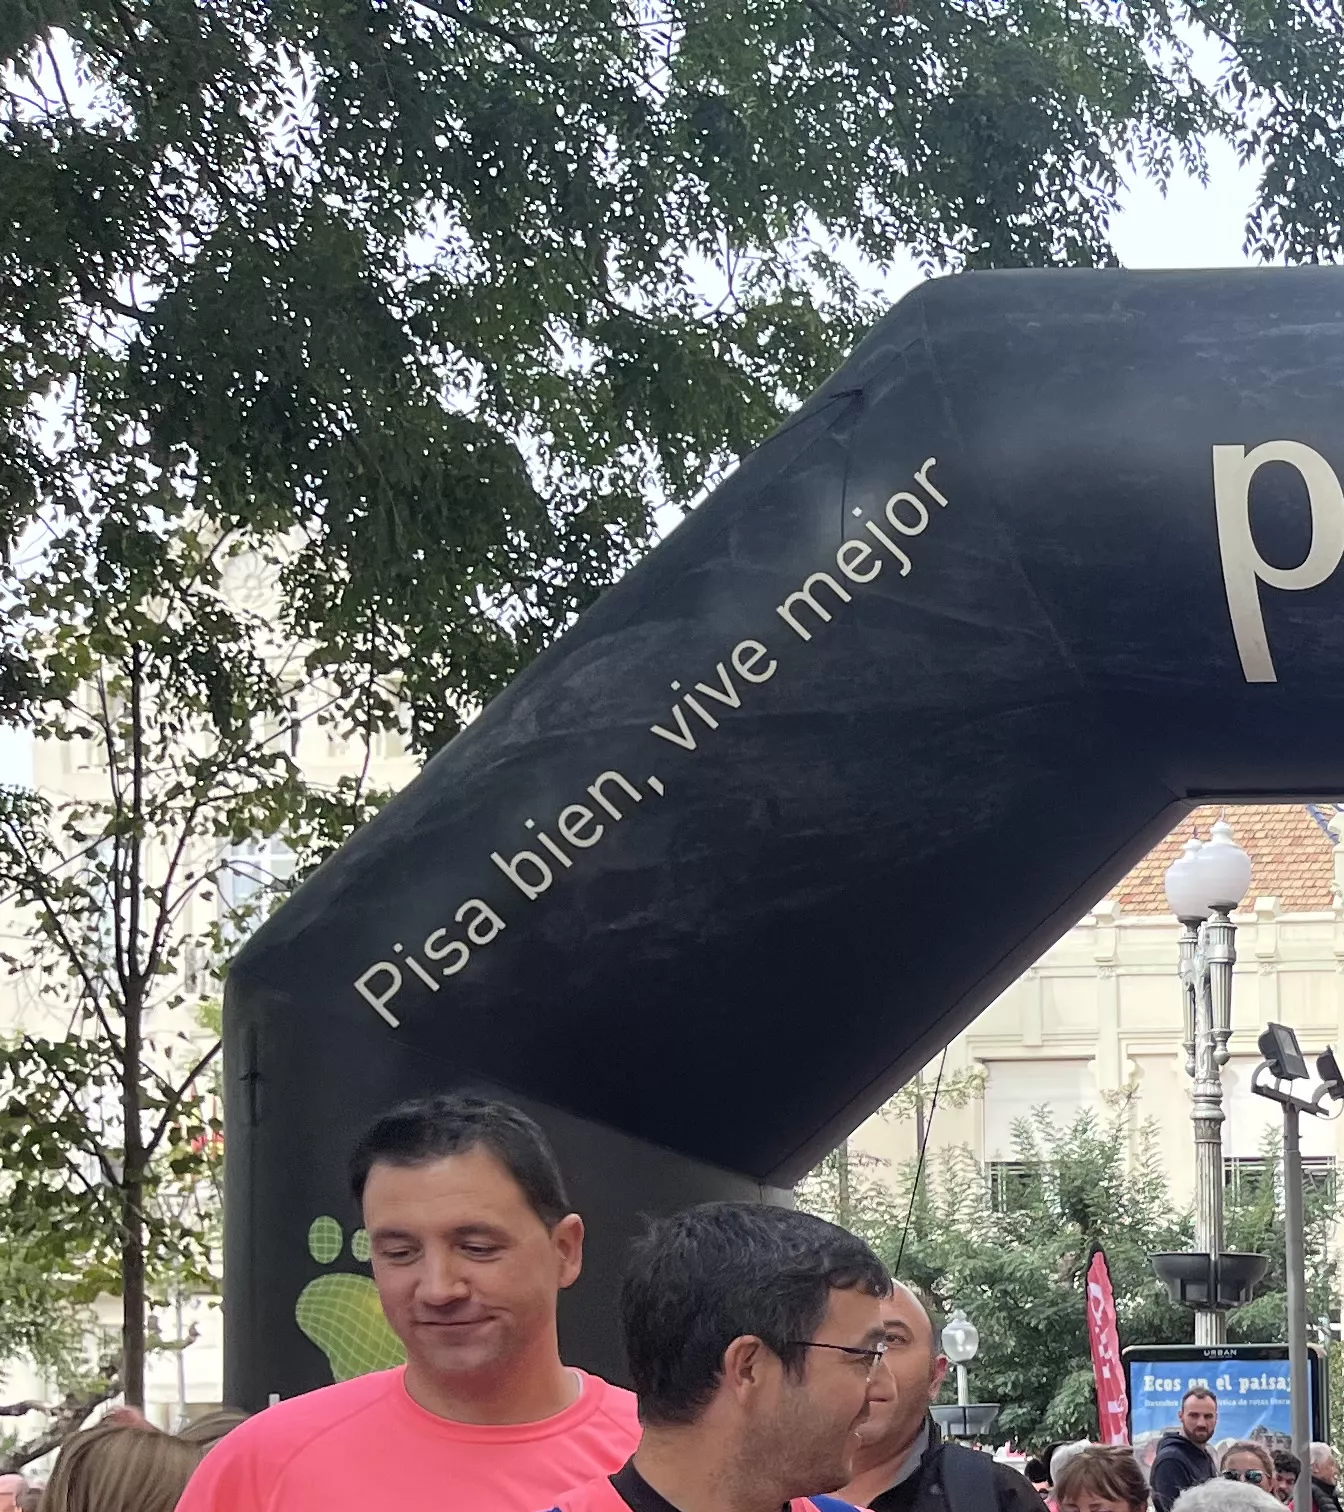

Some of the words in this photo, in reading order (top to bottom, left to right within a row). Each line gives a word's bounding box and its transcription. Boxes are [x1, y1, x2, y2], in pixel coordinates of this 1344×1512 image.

[353, 897, 507, 1029] Pisa
[490, 765, 666, 902] bien,
[649, 637, 778, 753] vive
[776, 455, 951, 642] mejor
[1143, 1375, 1182, 1392] Ecos
[1215, 1374, 1233, 1391] el
